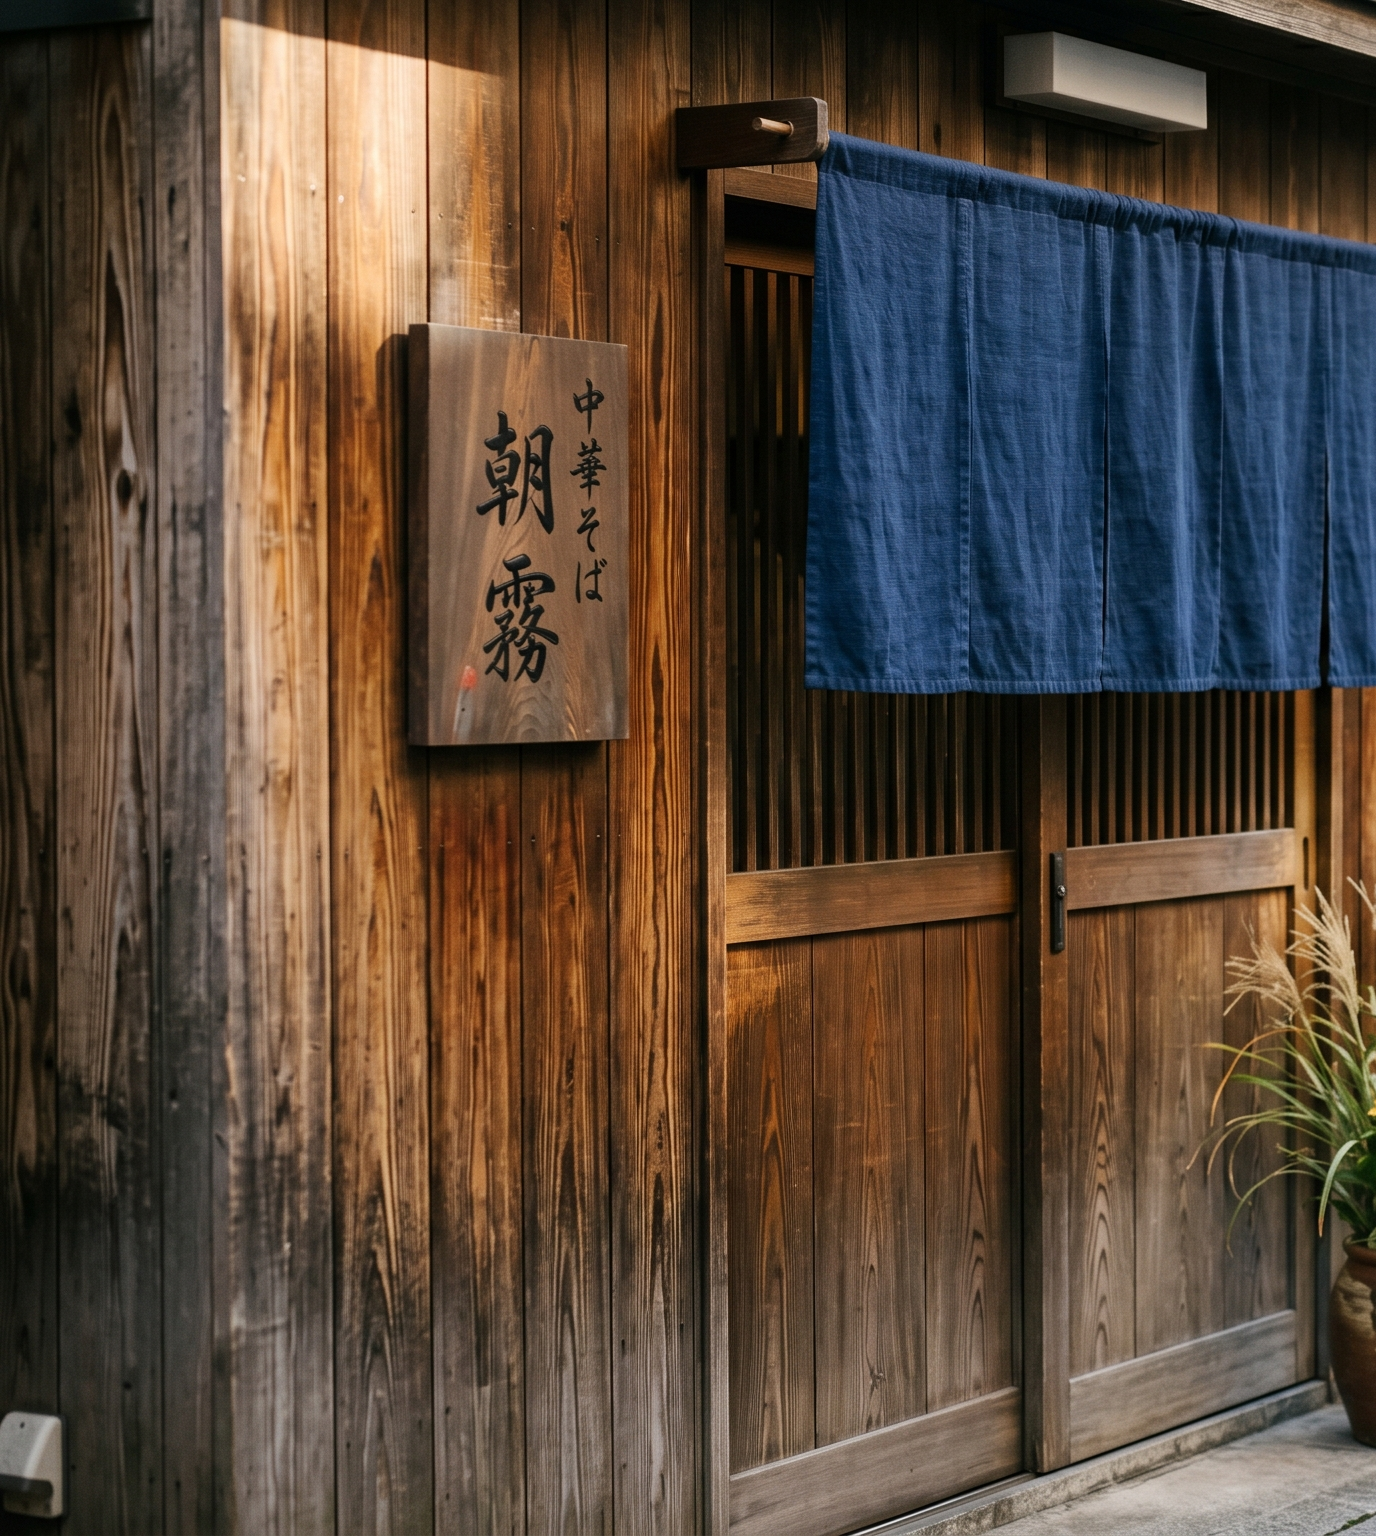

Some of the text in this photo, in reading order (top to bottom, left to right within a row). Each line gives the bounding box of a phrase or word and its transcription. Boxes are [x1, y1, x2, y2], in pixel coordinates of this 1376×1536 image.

[476, 410, 559, 683] 朝霧
[569, 377, 607, 603] 中華そば
